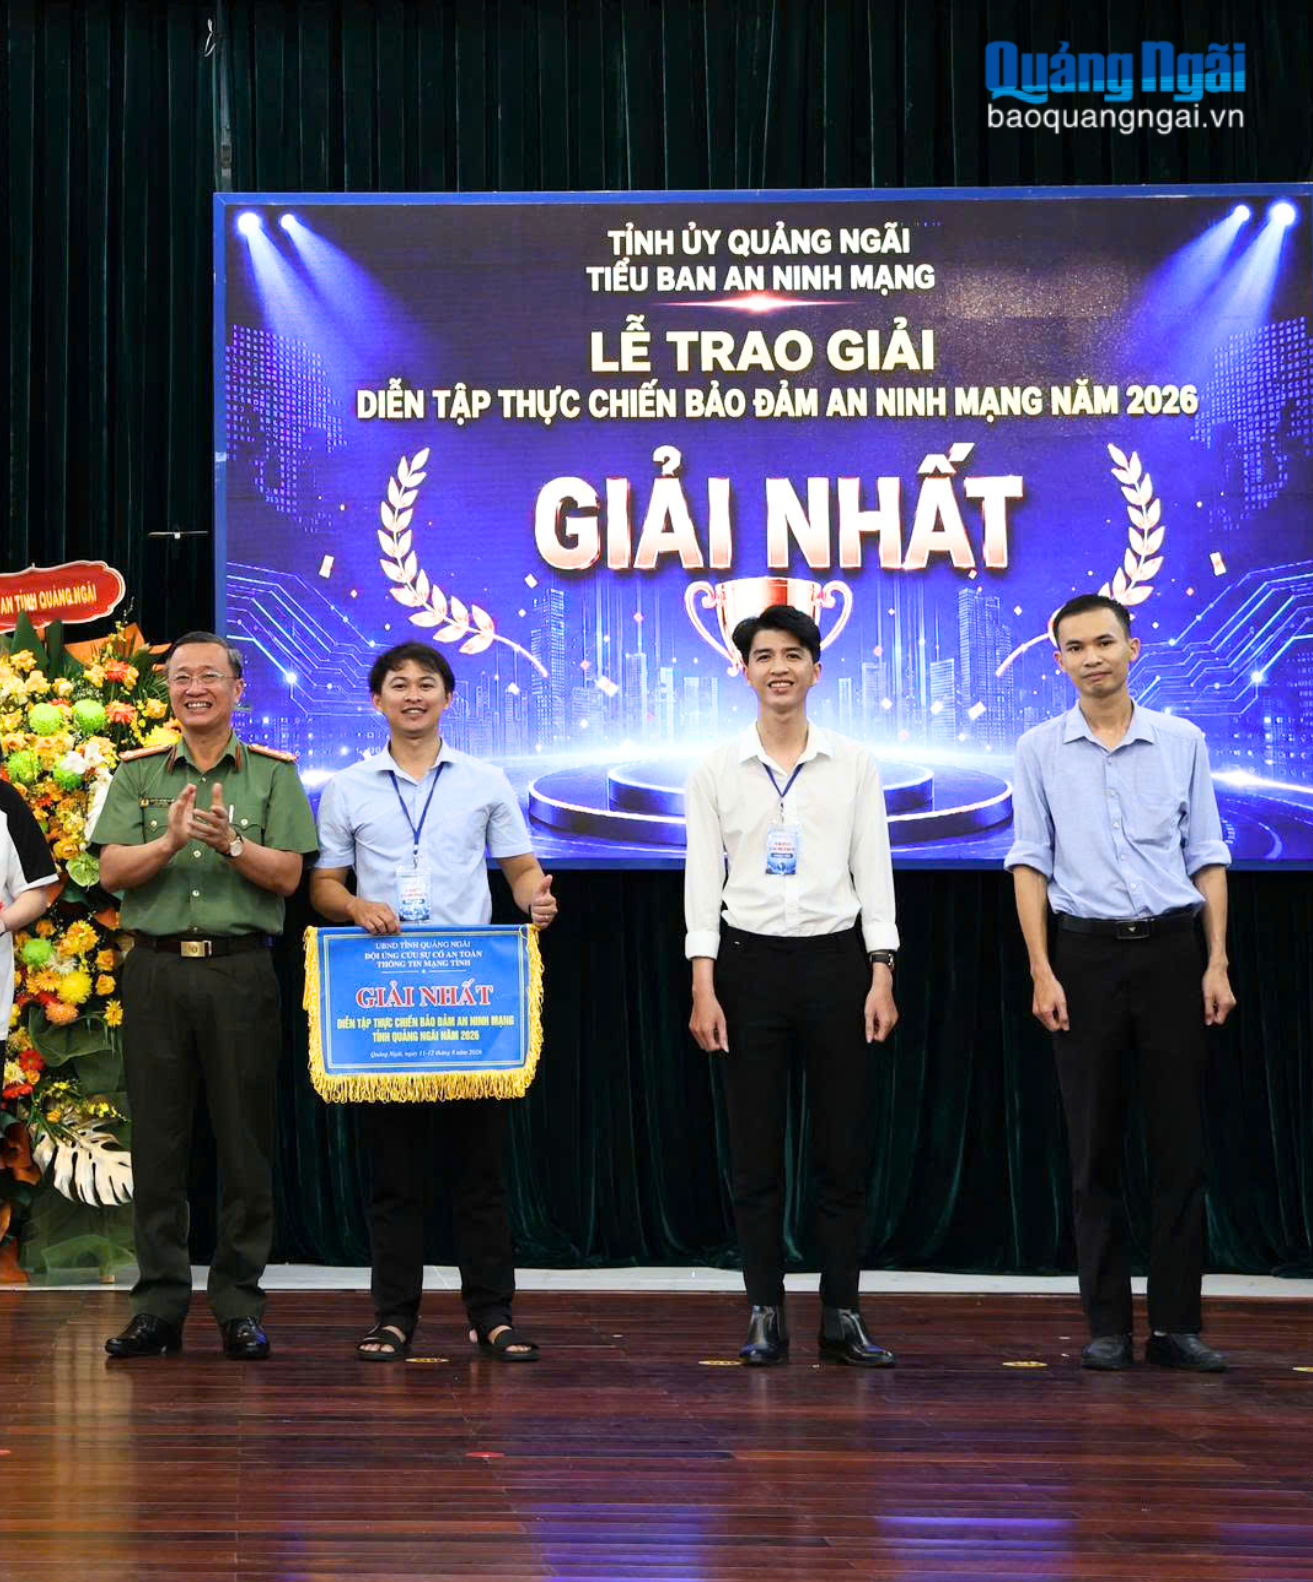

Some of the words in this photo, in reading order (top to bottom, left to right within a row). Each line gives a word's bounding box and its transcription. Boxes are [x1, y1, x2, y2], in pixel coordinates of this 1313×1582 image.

[607, 222, 674, 255] TỈNH
[682, 222, 721, 254] ỦY
[728, 221, 832, 257] QUẢNG
[840, 222, 910, 253] NGÃI
[586, 257, 649, 291] TIỂU
[657, 267, 716, 291] BAN
[724, 266, 765, 290] AN
[773, 265, 841, 289] NINH
[850, 264, 935, 296] MẠNG
[591, 314, 651, 372] LỄ
[666, 329, 813, 372] TRAO
[826, 316, 934, 371] GIẢI
[357, 377, 424, 419] DIỄN
[432, 382, 490, 426] TẬP
[498, 385, 581, 425] THỰC
[588, 377, 677, 418] CHIẾN
[685, 380, 746, 418] BẢO
[752, 379, 818, 418] ĐẢM
[826, 387, 868, 417] AN
[875, 387, 946, 417] NINH
[954, 386, 1043, 424] MẠNG
[1051, 378, 1119, 416] NĂM
[1126, 384, 1199, 415] 2026
[534, 444, 734, 571] GIẢI
[764, 442, 1024, 570] NHẤT
[0, 595, 14, 615] AN
[406, 961, 422, 969] TIN
[446, 951, 460, 959] AN
[356, 980, 415, 1008] GIẢI
[418, 978, 494, 1007] NHẤT
[457, 1016, 469, 1026] AN
[469, 1015, 489, 1026] NINH
